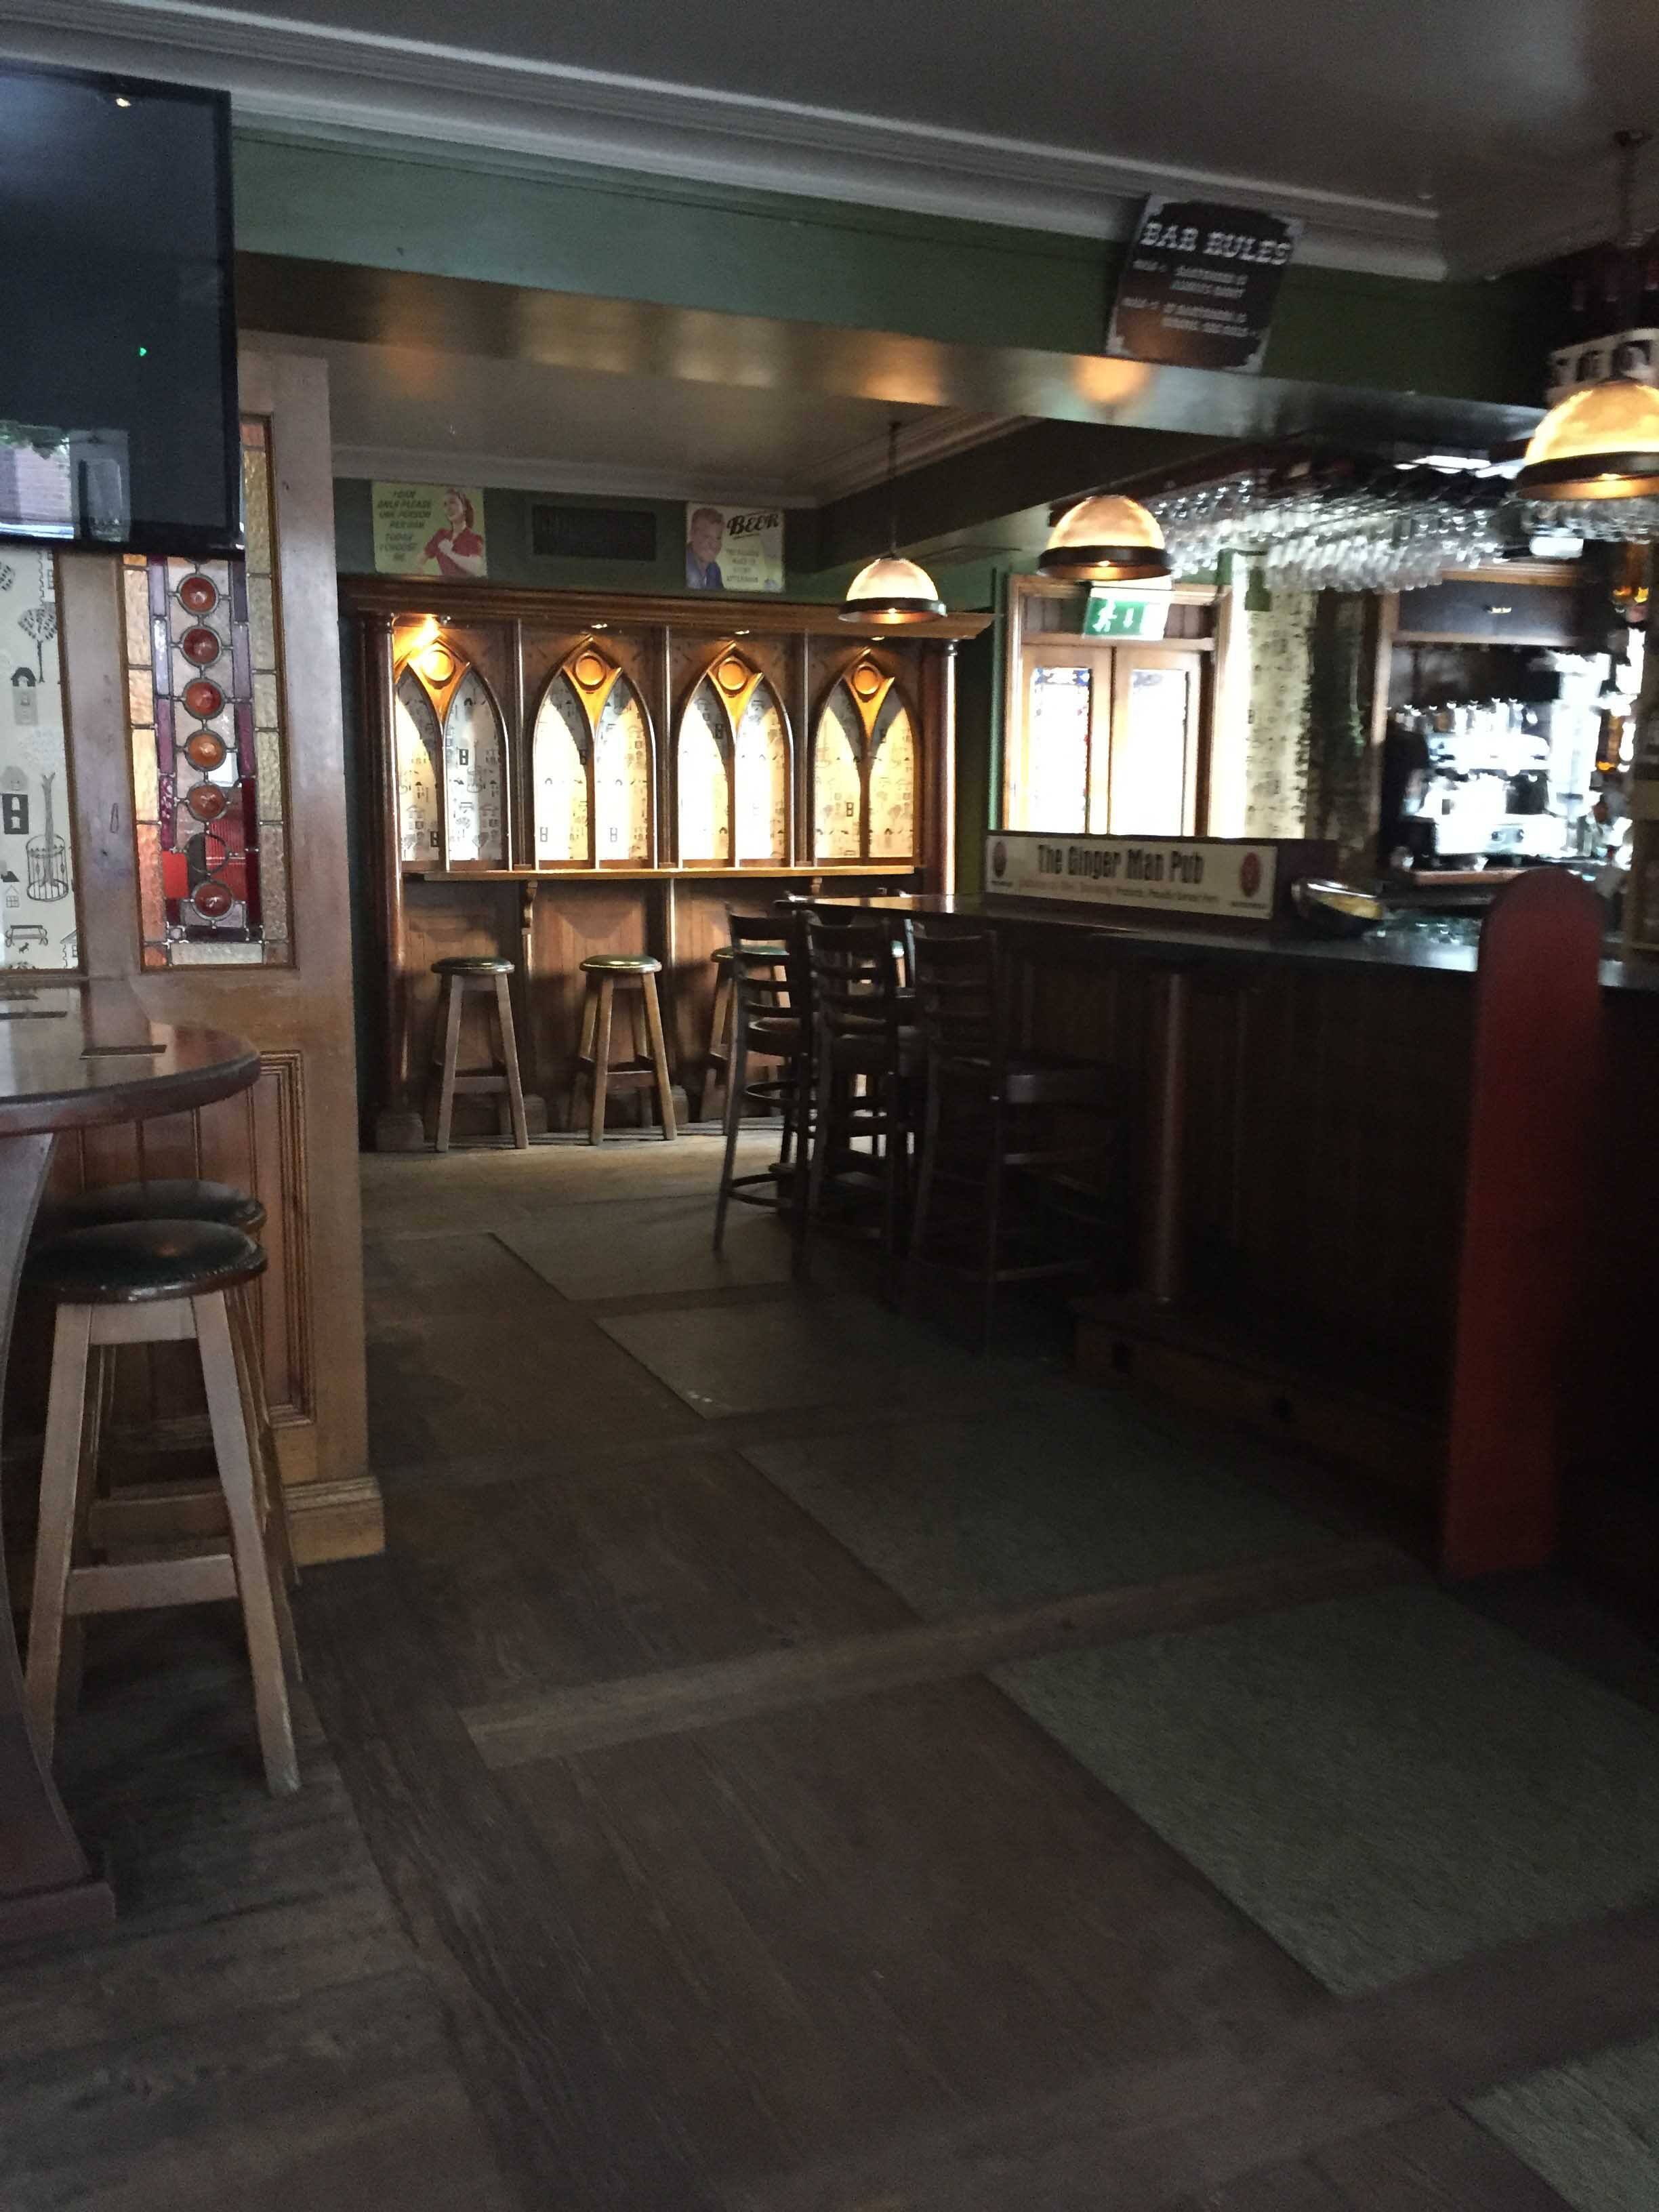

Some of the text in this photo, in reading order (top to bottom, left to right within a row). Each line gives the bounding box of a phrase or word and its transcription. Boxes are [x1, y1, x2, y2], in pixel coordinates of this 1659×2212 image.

[726, 513, 779, 536] BEER
[1038, 844, 1204, 884] The Ginger Man Pub
